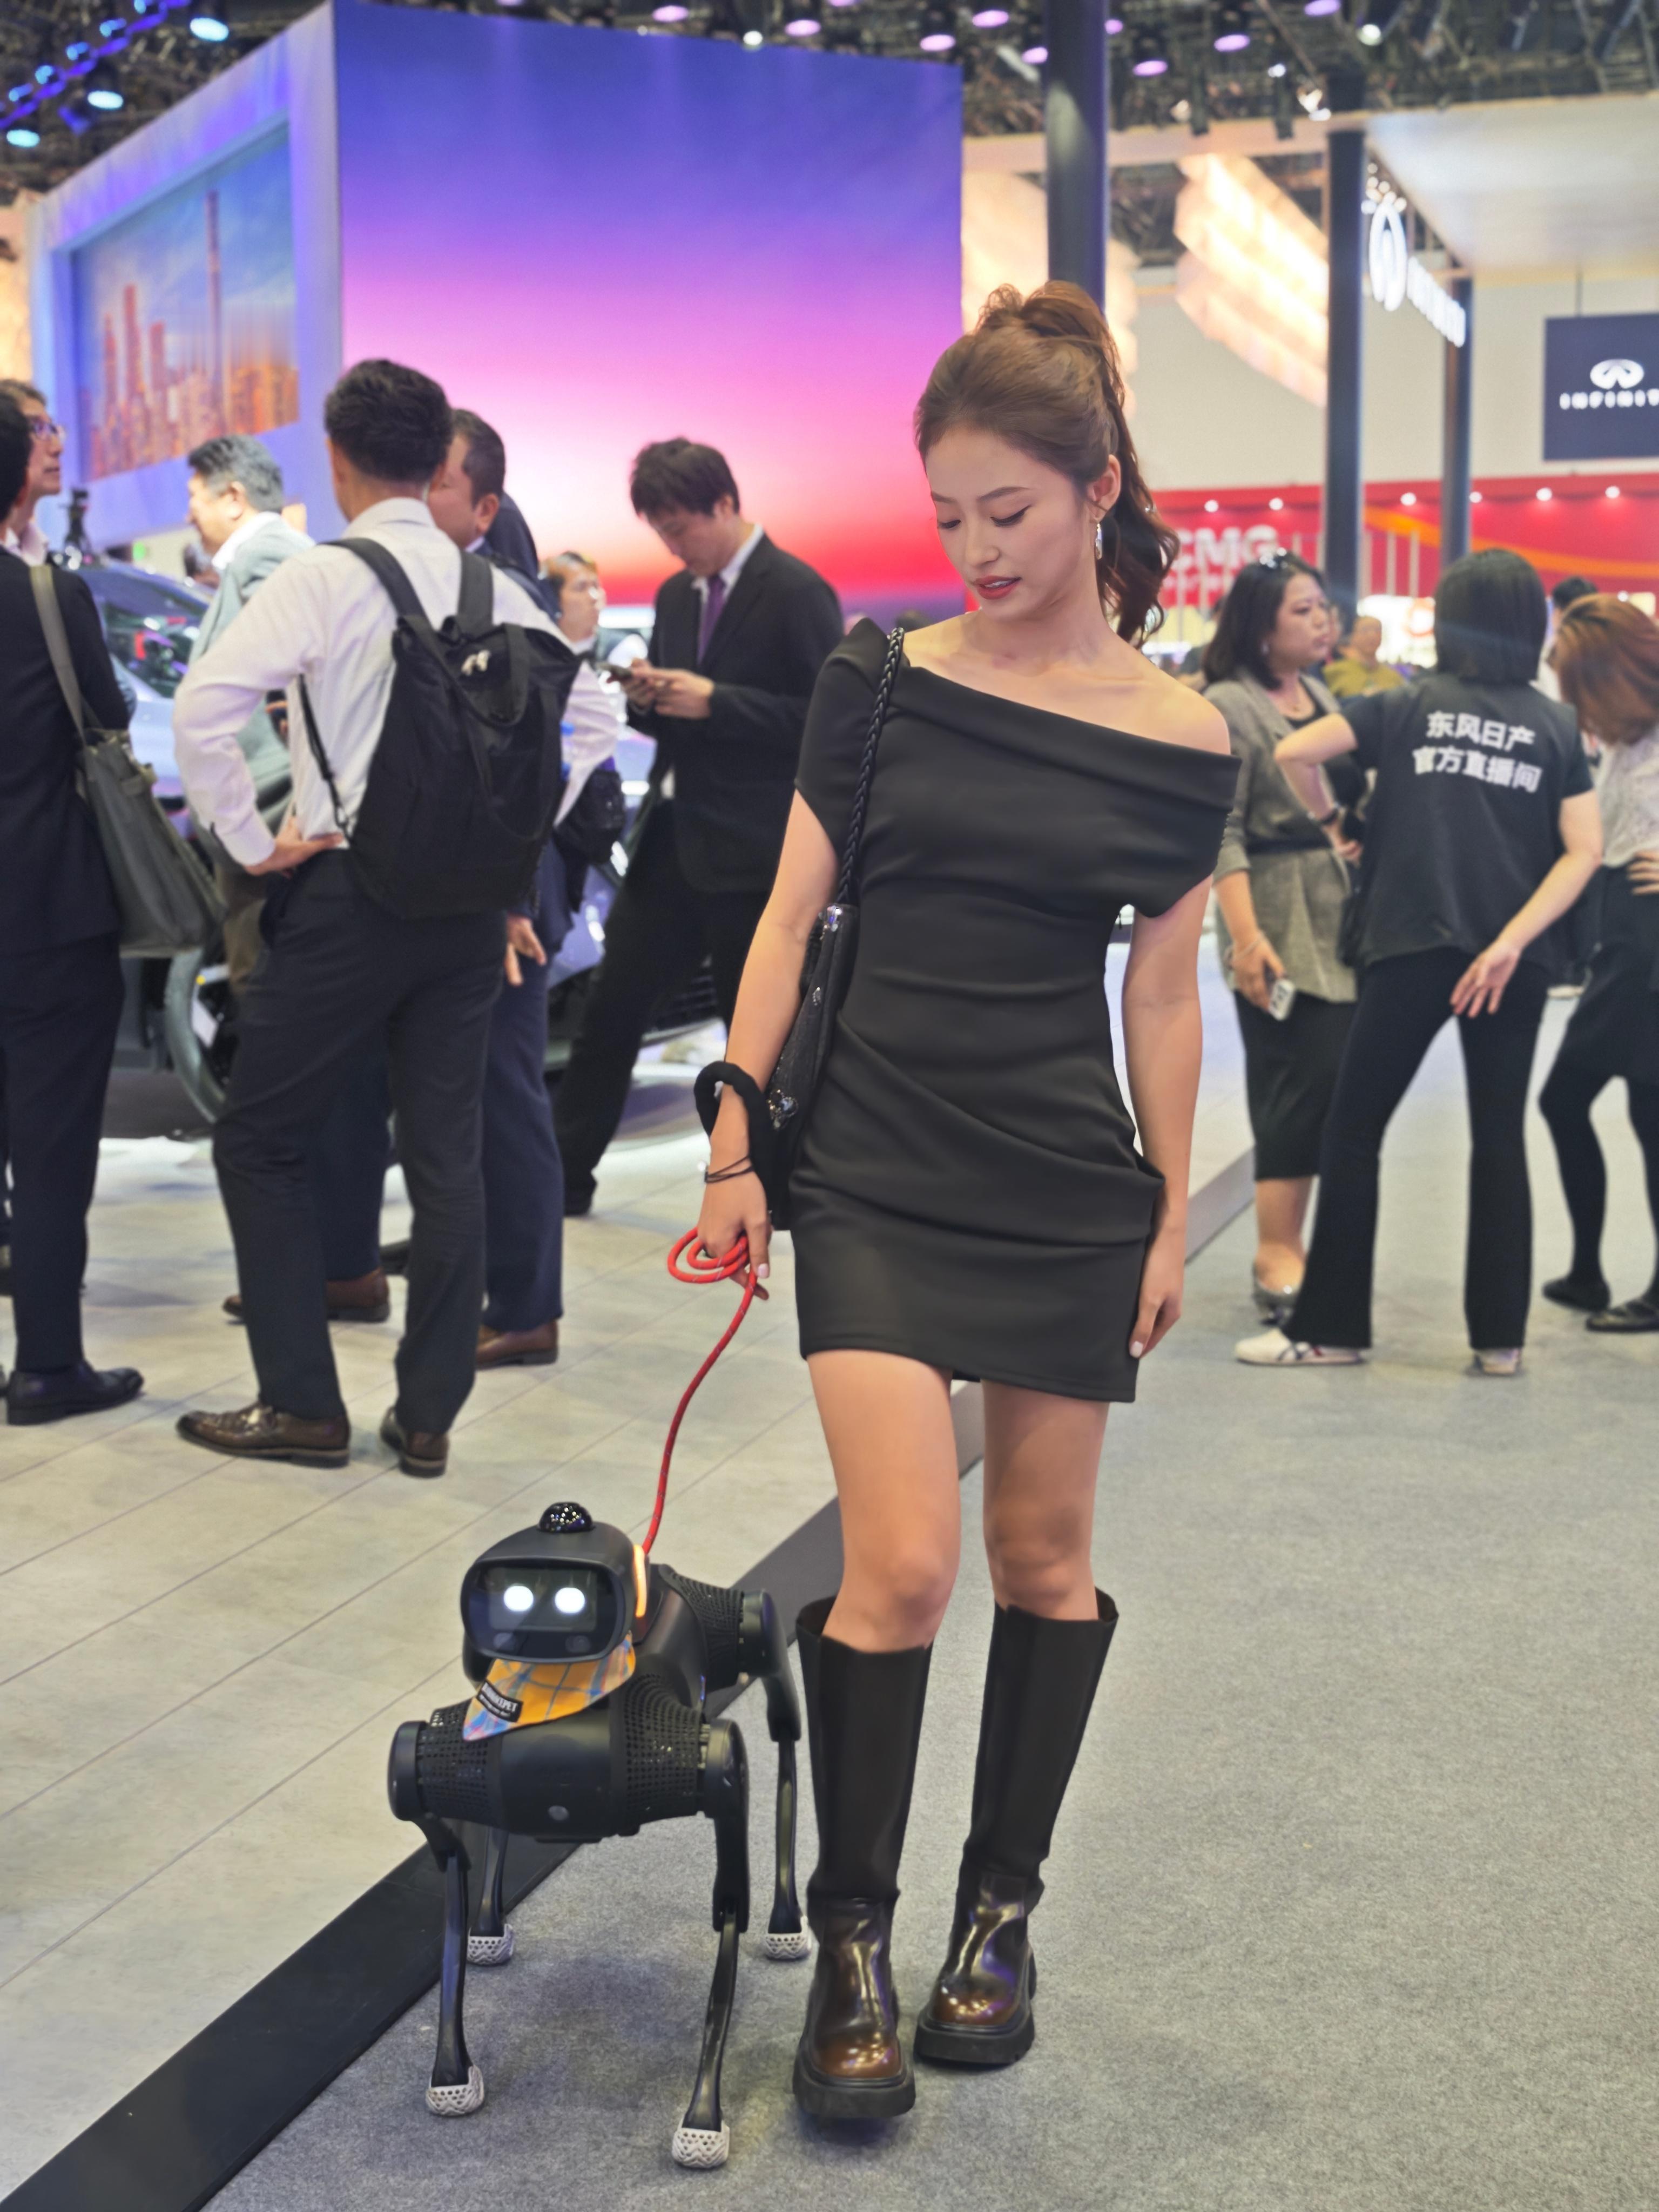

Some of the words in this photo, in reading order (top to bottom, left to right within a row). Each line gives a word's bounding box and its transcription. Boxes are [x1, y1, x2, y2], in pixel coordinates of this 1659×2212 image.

[1426, 711, 1535, 751] 东风日产
[1412, 745, 1542, 793] 官方直播间
